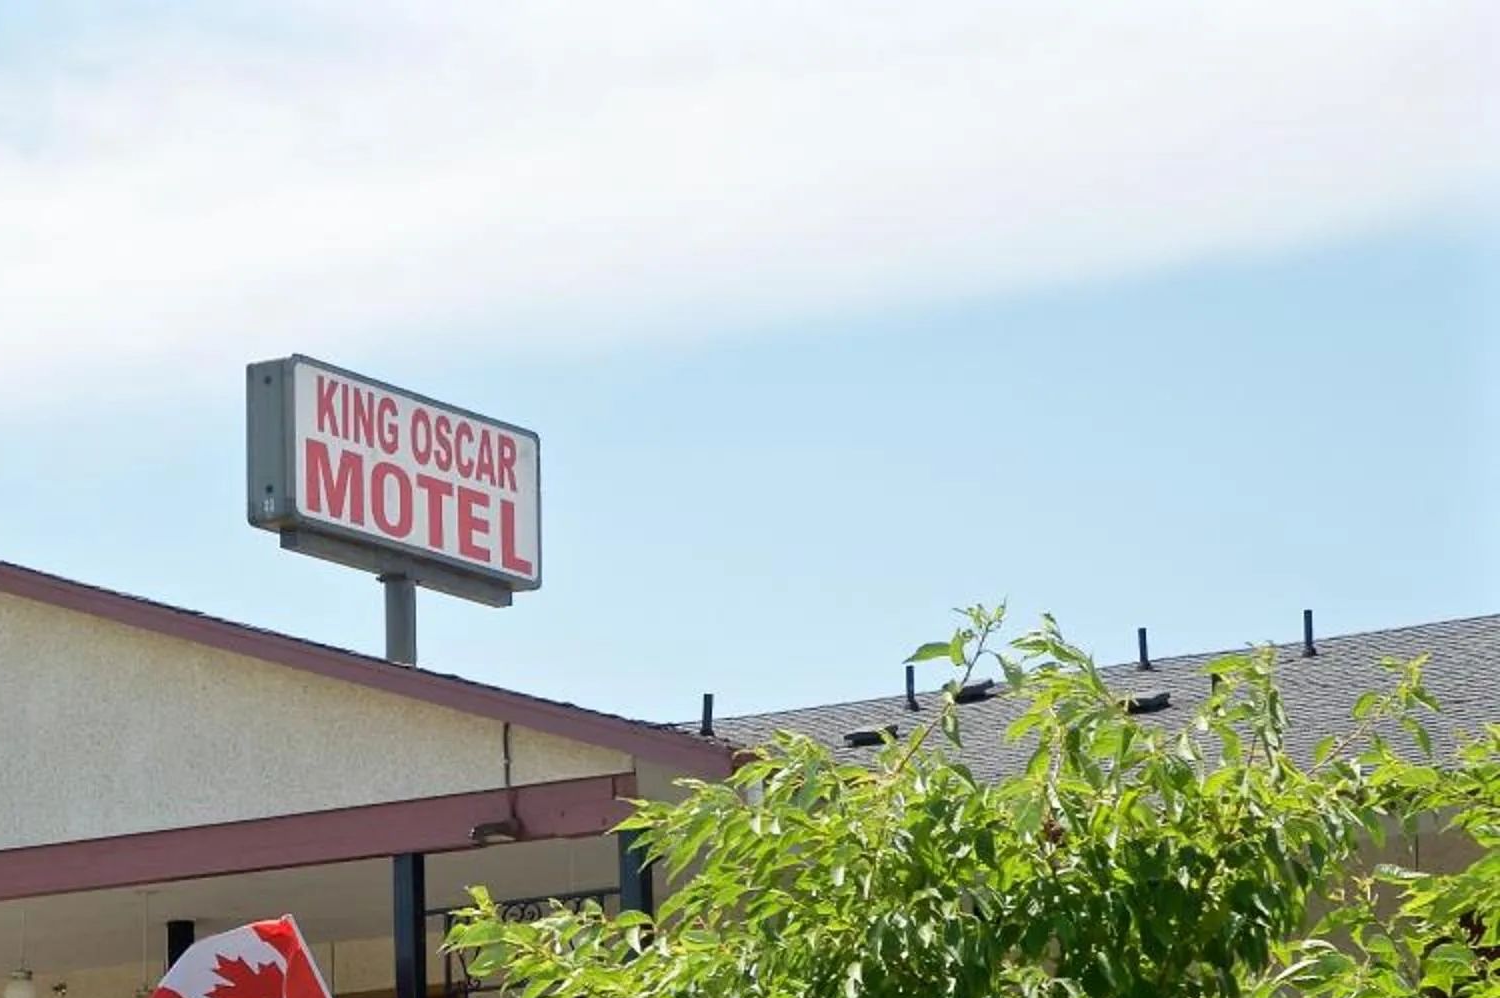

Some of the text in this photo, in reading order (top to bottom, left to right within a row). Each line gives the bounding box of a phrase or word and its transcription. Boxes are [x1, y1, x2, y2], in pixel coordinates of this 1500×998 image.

[316, 375, 517, 493] KING OSCAR
[305, 437, 533, 576] MOTEL
